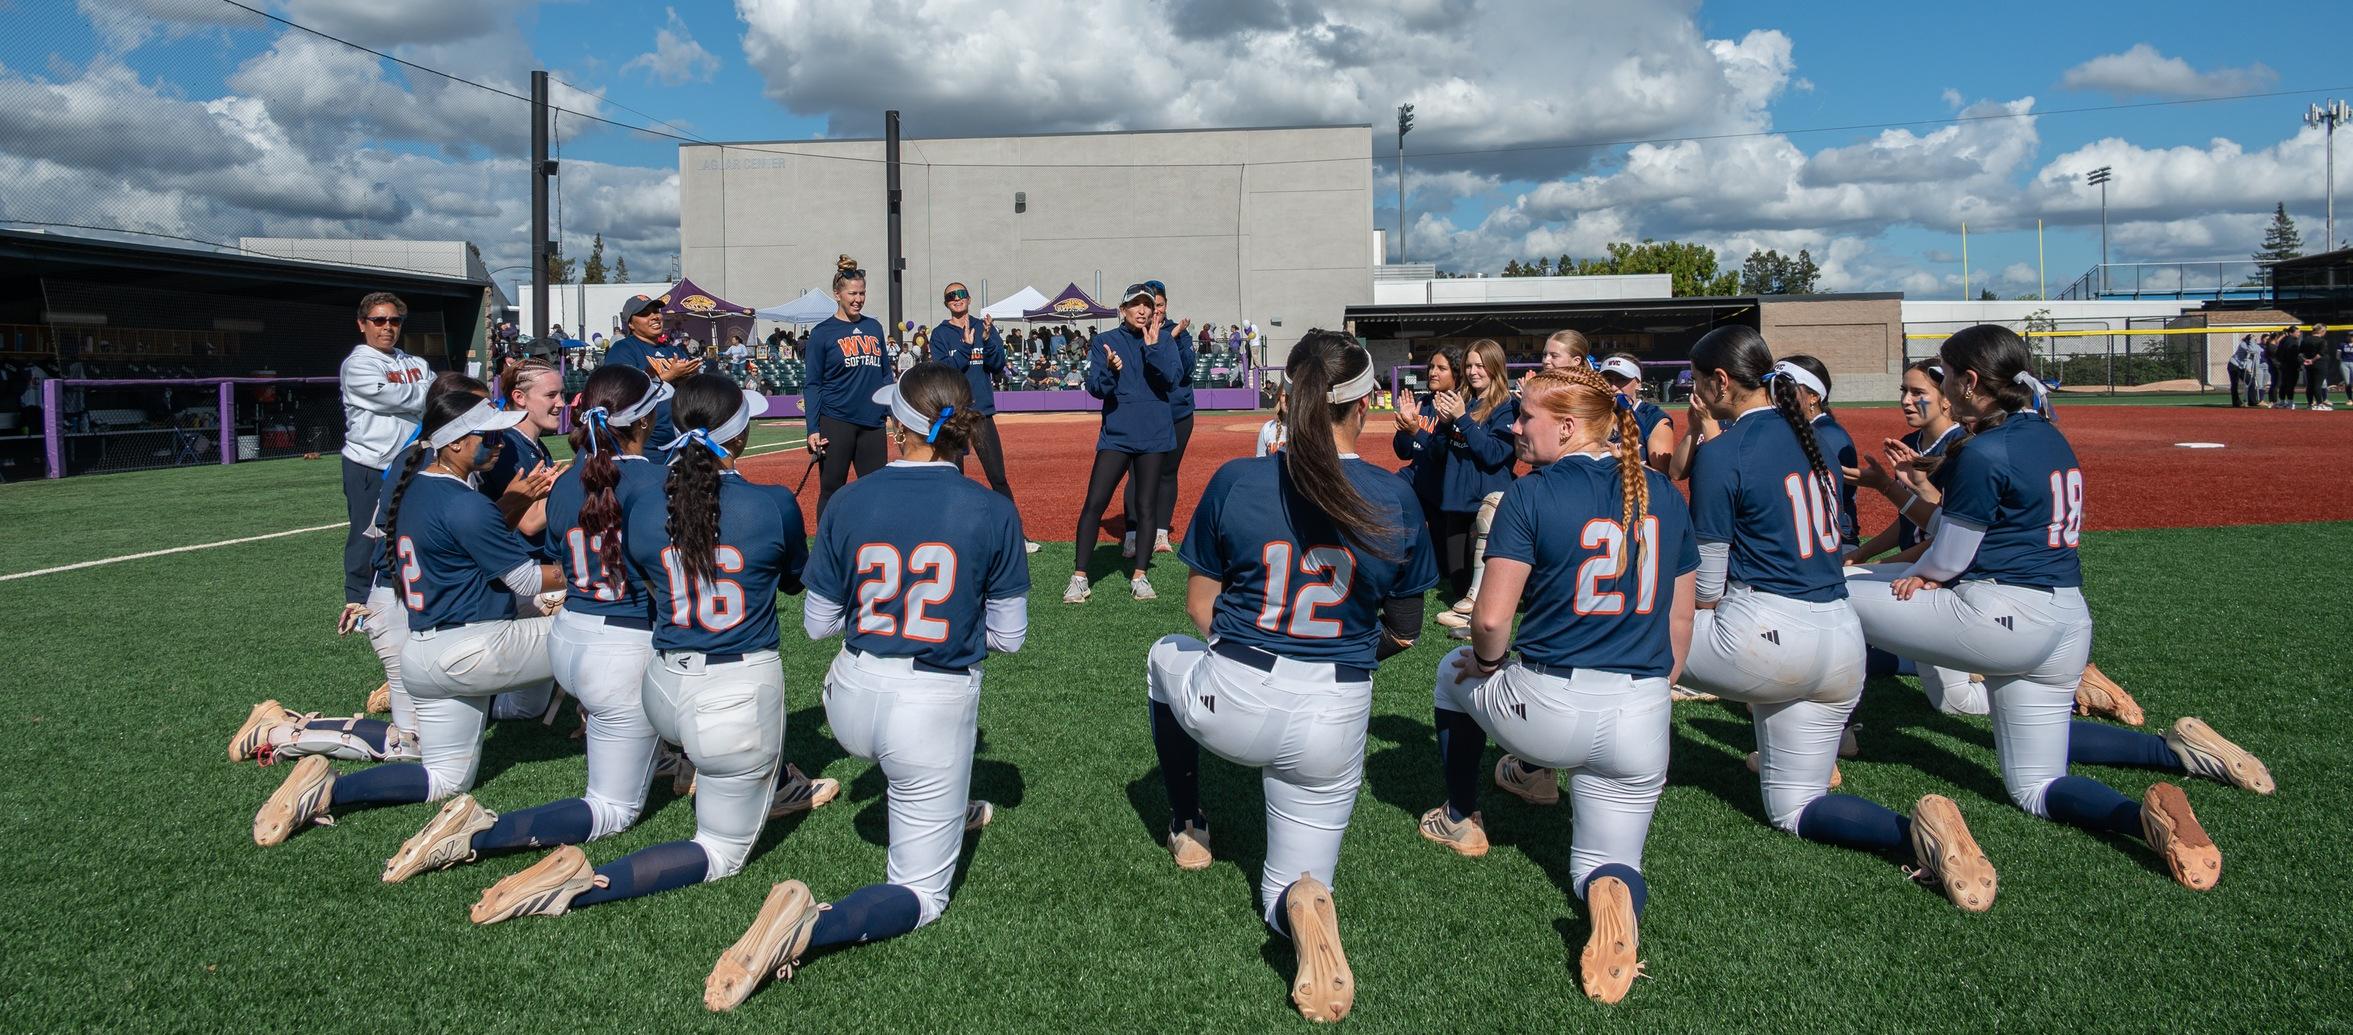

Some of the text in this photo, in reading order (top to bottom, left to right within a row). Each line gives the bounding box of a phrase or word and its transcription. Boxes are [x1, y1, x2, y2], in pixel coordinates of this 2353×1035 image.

[837, 335, 881, 358] WVC
[844, 355, 881, 368] SOFTBALL
[1784, 470, 1841, 560] 10
[2047, 468, 2083, 548] 18
[397, 535, 424, 612] 2
[660, 544, 746, 632] 16
[855, 541, 958, 643] 22
[1256, 540, 1356, 639] 12
[1573, 515, 1660, 615] 21
